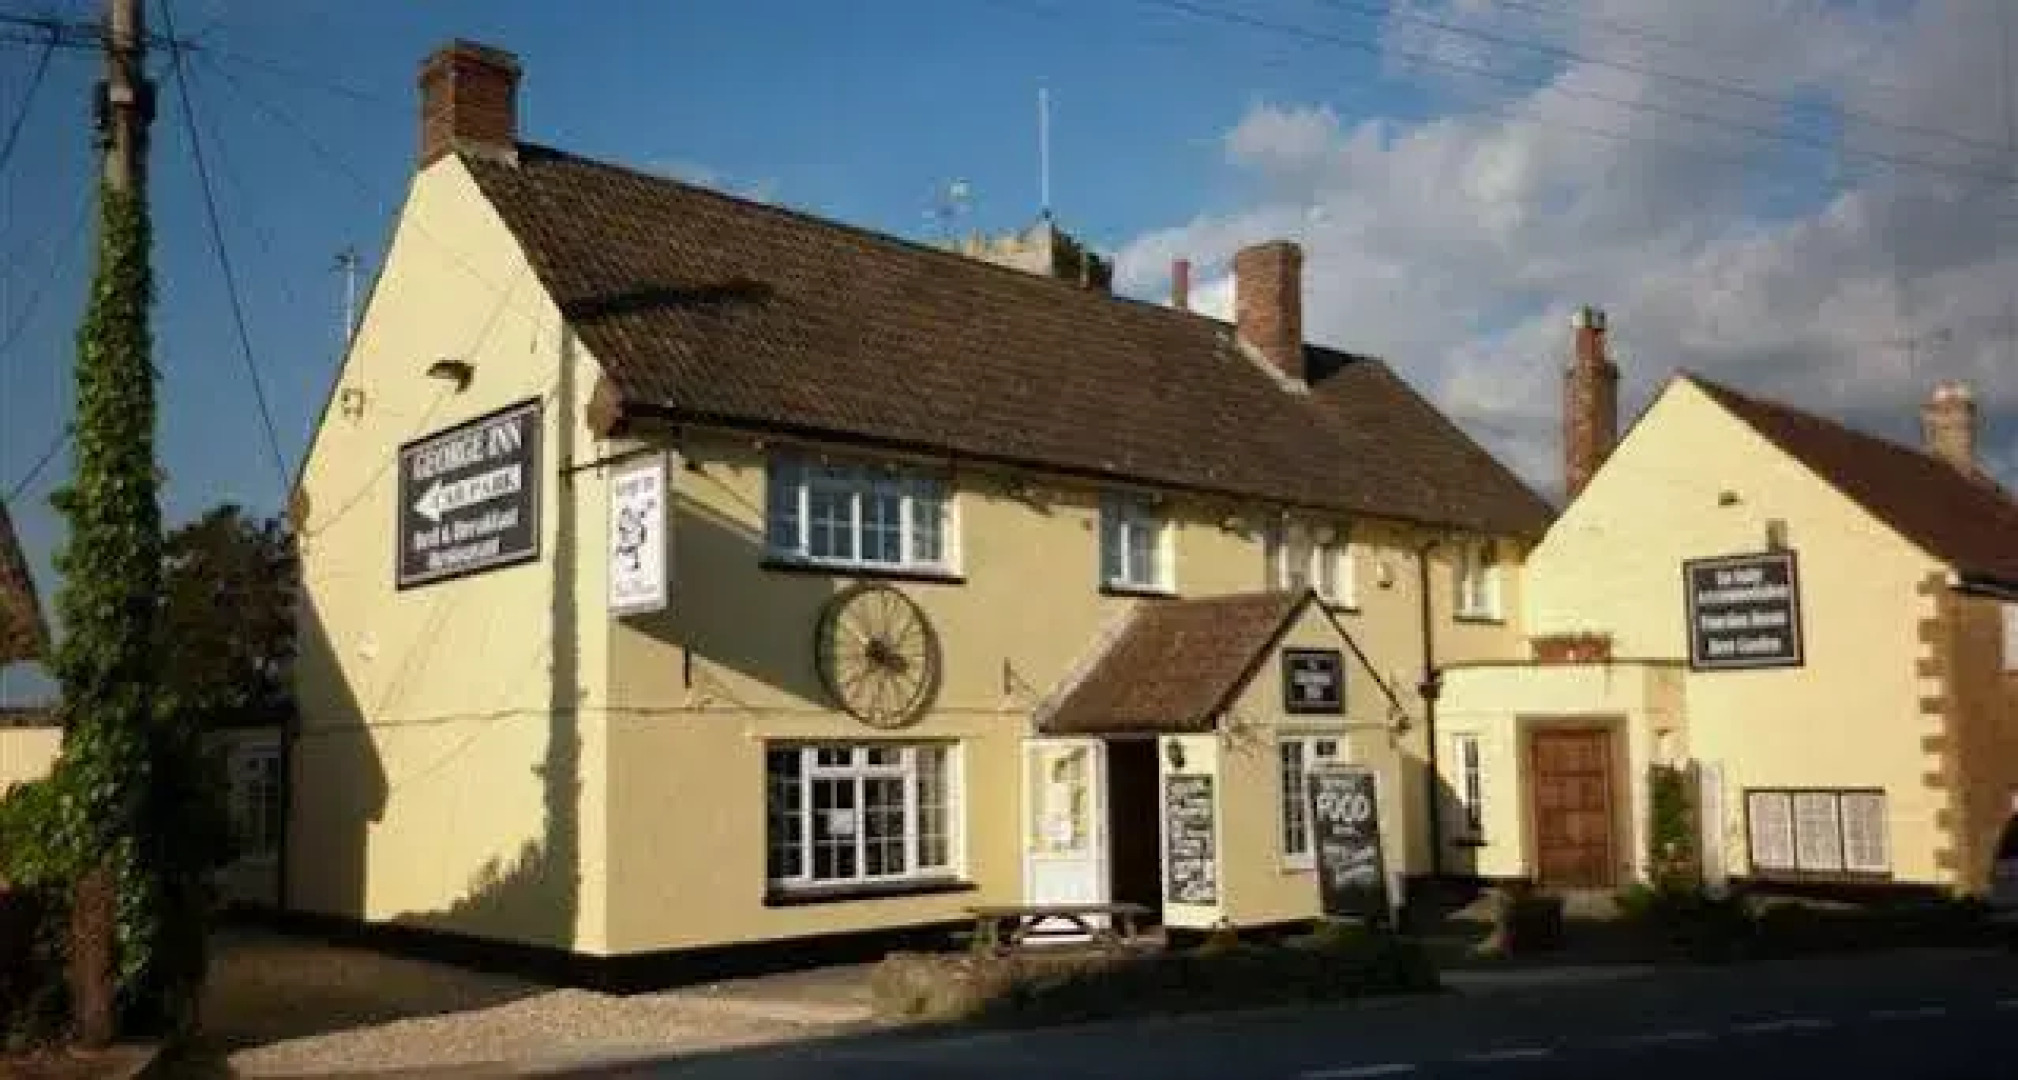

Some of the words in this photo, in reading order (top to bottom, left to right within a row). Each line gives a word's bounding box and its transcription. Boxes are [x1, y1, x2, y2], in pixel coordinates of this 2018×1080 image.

[412, 426, 485, 480] GEORGE
[488, 418, 523, 458] INN
[469, 470, 516, 499] PARK
[1316, 794, 1371, 822] FOOD
